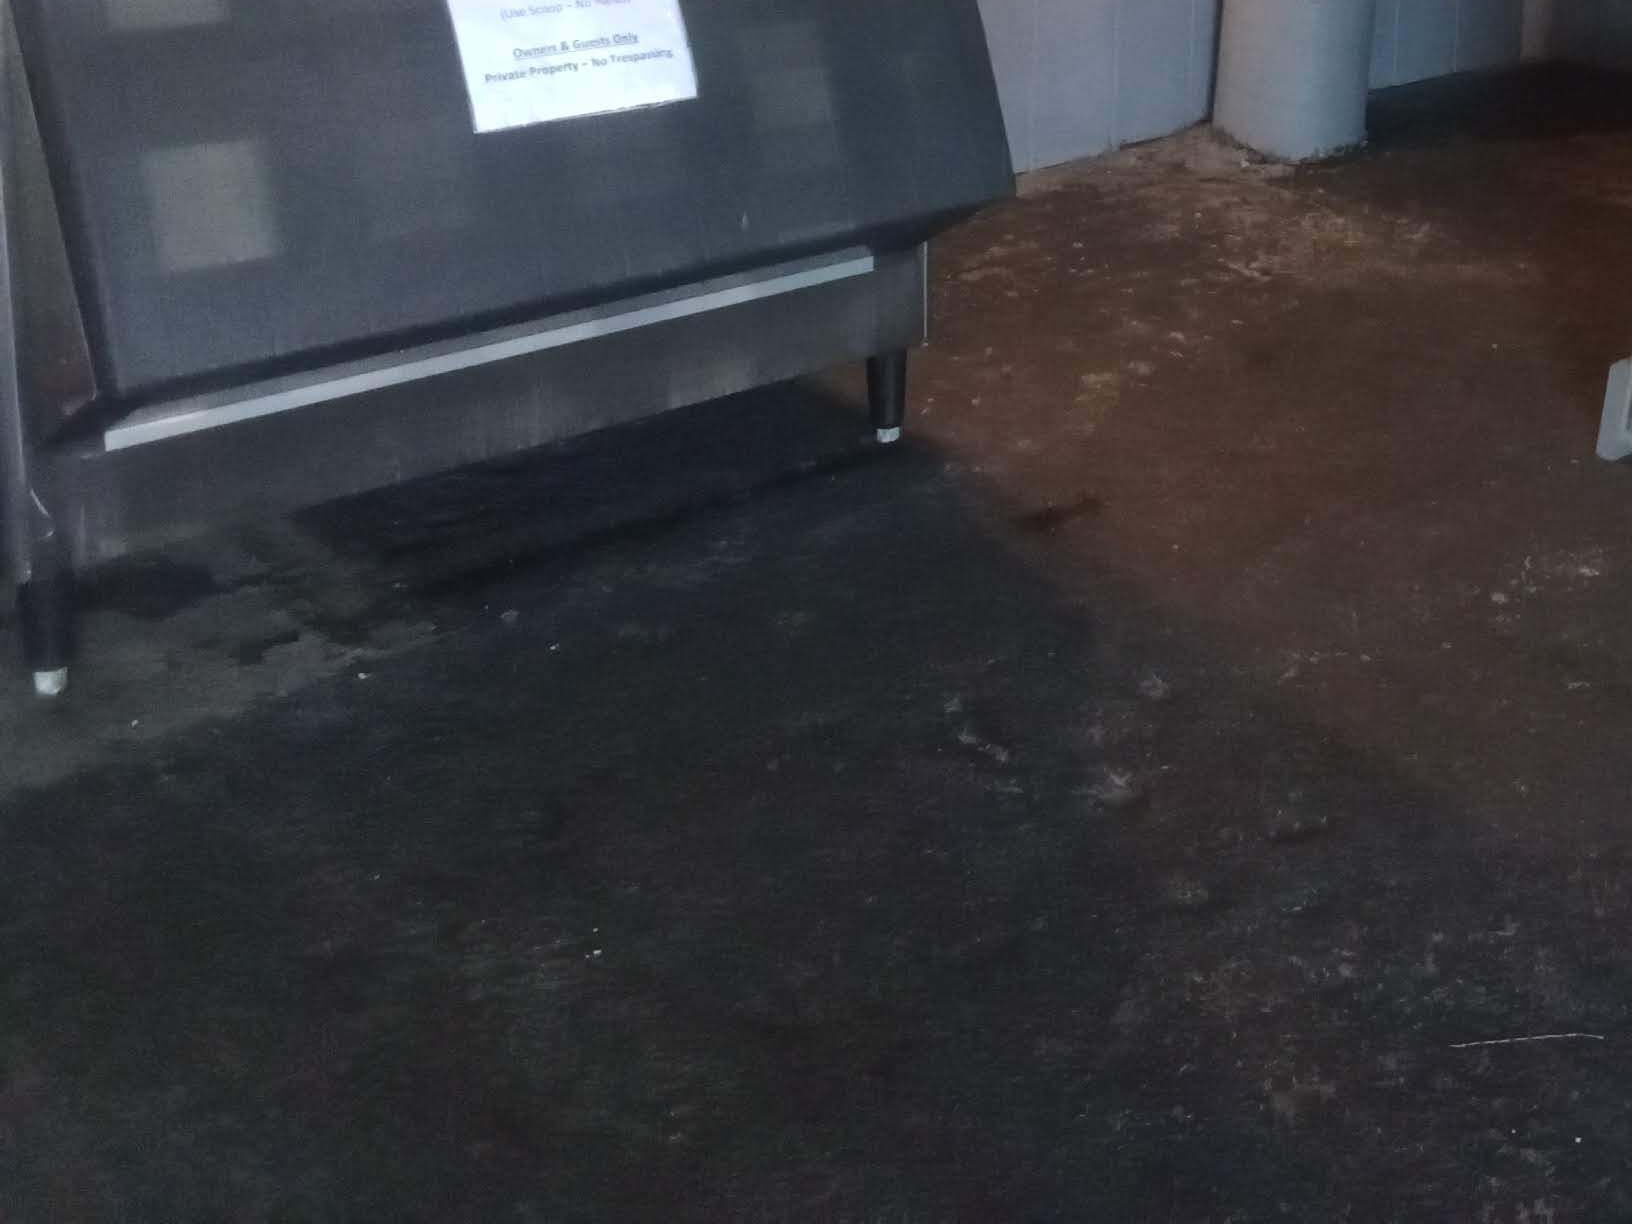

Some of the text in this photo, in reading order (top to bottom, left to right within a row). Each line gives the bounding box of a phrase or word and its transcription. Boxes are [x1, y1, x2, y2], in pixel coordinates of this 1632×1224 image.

[512, 43, 558, 59] Owners
[572, 35, 611, 51] Guests
[612, 31, 640, 48] Only
[484, 66, 528, 84] Private
[528, 59, 579, 78] Property
[591, 56, 609, 68] No
[609, 47, 674, 64] Trespassing
